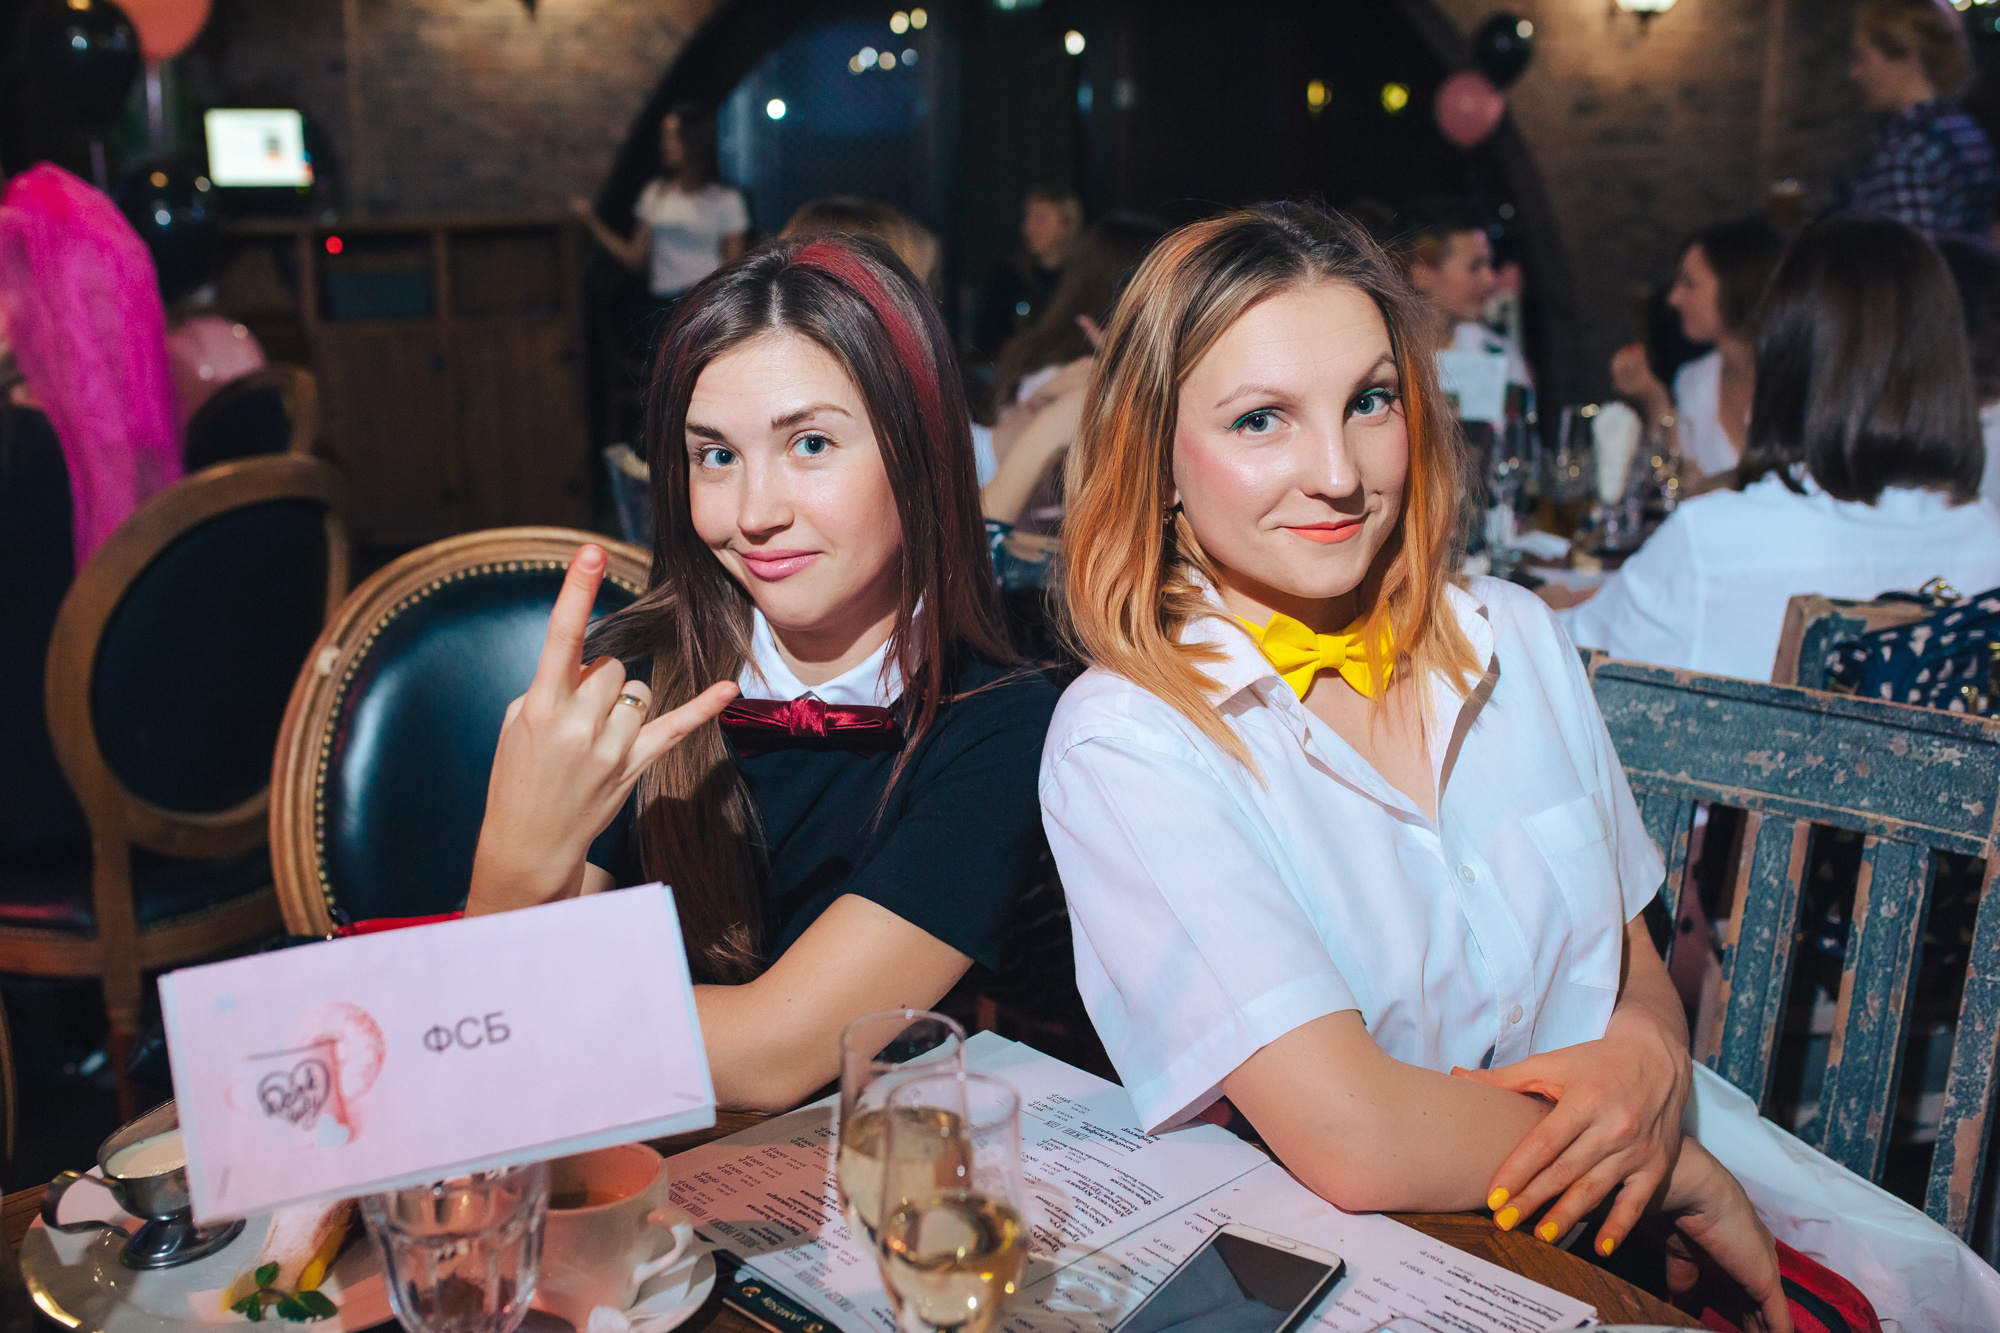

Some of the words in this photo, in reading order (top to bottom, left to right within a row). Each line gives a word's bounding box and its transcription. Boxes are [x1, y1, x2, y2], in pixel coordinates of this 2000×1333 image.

[423, 1011, 511, 1053] ФСБ
[1042, 1119, 1060, 1128] GIN
[1079, 1124, 1108, 1139] Сапфир
[1092, 1125, 1118, 1138] Sapphire
[1061, 1127, 1089, 1140] ДЖИН
[1120, 1127, 1153, 1144] Бифитер
[1118, 1136, 1142, 1149] Bombay
[1109, 1177, 1151, 1205] Финляндия
[1137, 1180, 1164, 1198] Finlandia
[765, 1192, 796, 1210] Стандарт
[1034, 1194, 1054, 1207] Citron
[1071, 1195, 1089, 1209] Vodka
[1093, 1195, 1129, 1217] Абсолют
[1115, 1194, 1140, 1211] Absolut
[796, 1208, 824, 1226] Русский
[1073, 1204, 1105, 1227] Абсолют
[1089, 1207, 1113, 1224] Absolut
[1060, 1227, 1079, 1242] Грей
[1080, 1222, 1094, 1234] Grey
[761, 1296, 806, 1322] JAMESON
